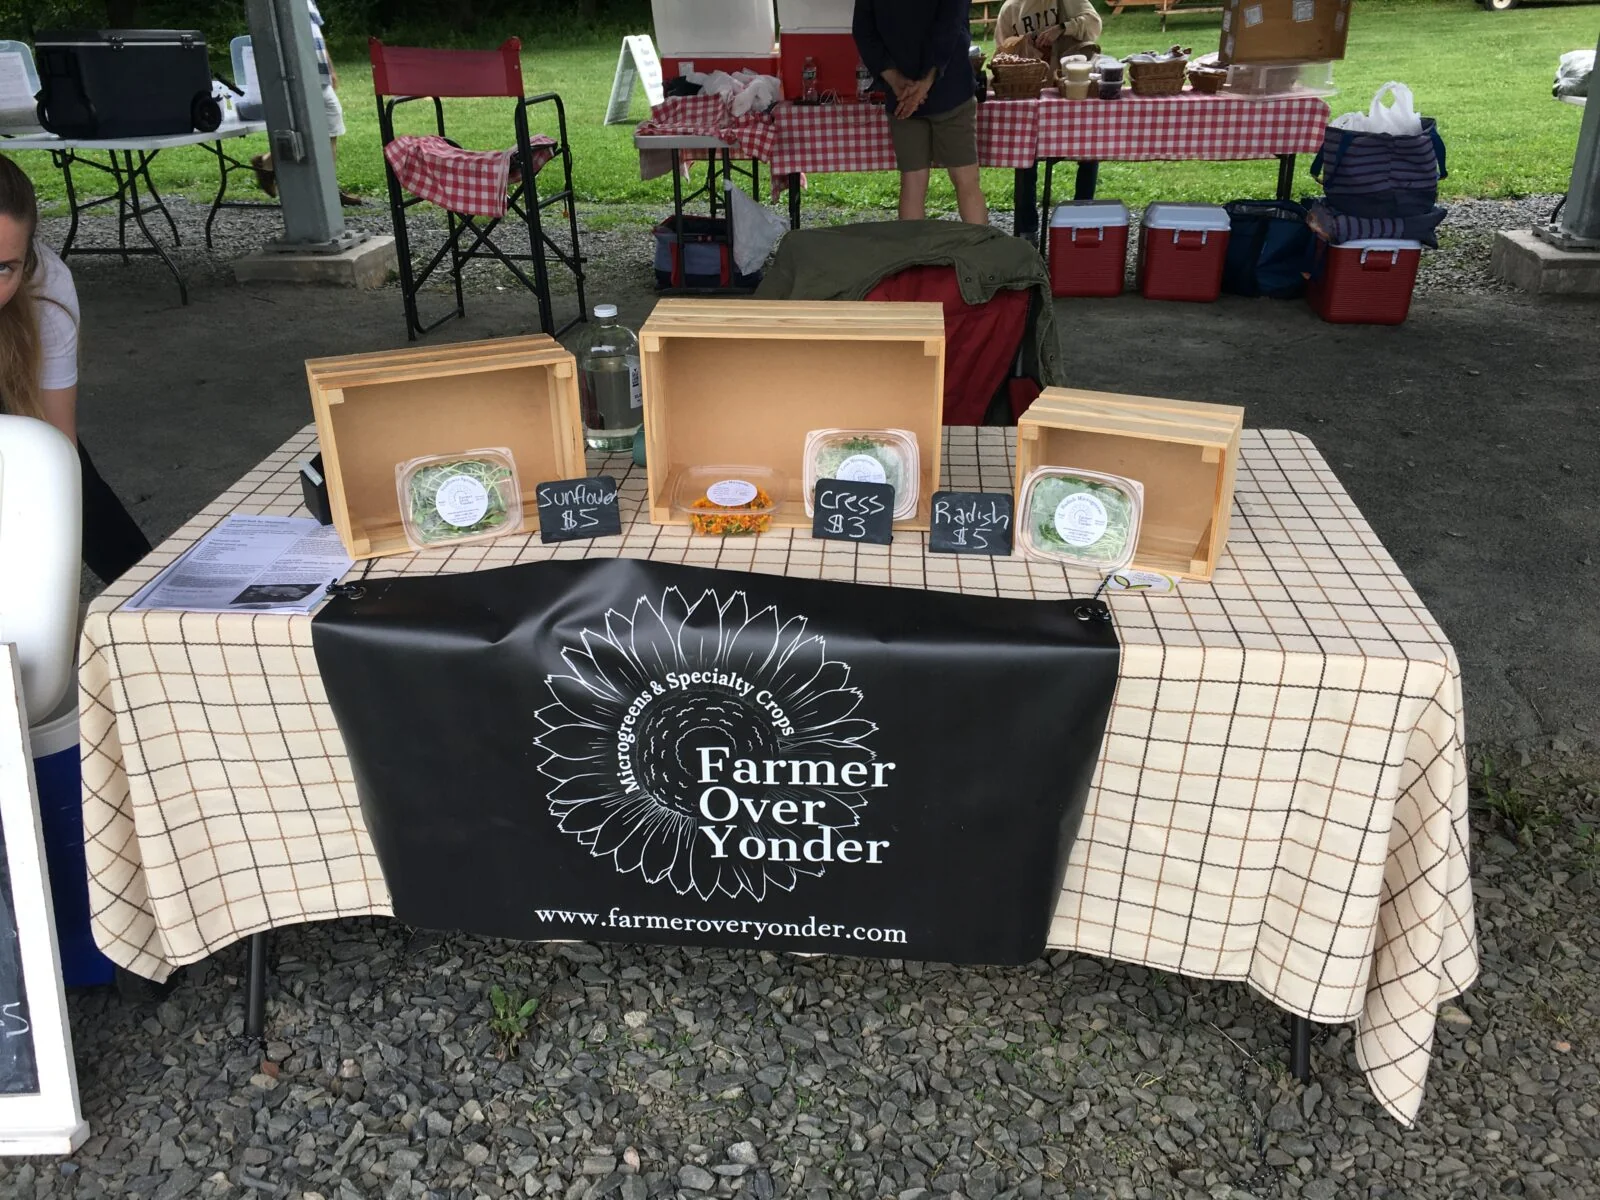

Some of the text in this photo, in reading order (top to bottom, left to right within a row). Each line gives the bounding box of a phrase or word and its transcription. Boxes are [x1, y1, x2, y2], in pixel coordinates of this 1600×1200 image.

[560, 507, 599, 531] $5
[824, 514, 866, 538] $3
[935, 501, 1009, 530] Radish
[951, 527, 992, 549] $5
[617, 668, 795, 794] Microgreens & Specialty Crops
[696, 746, 896, 787] Farmer
[699, 786, 826, 825] Over
[698, 825, 890, 864] Yonder
[534, 907, 908, 944] www.farmeroveryonder.com
